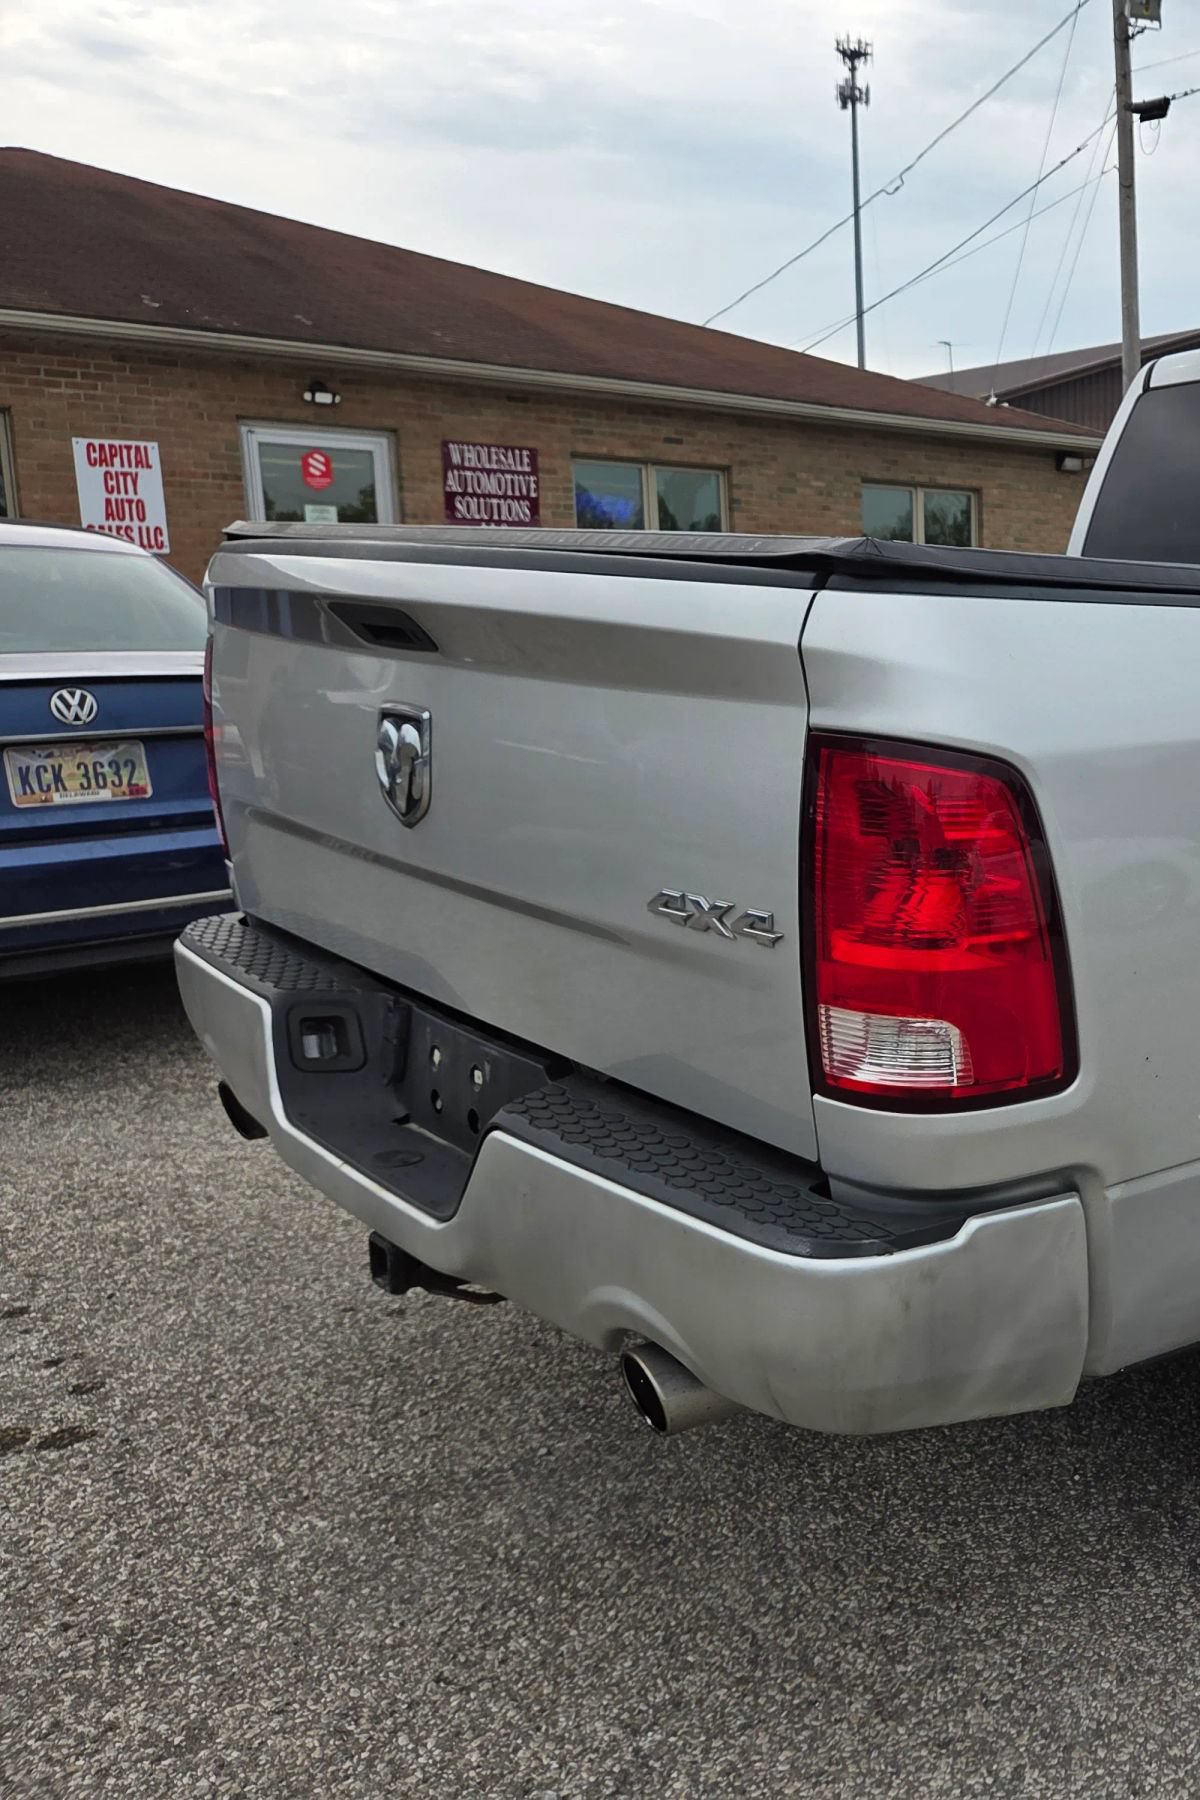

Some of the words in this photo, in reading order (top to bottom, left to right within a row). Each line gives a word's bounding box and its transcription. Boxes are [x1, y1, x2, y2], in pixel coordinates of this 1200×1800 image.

[86, 442, 152, 469] CAPITAL
[448, 443, 531, 472] WHOLESALE
[103, 470, 139, 496] CITY
[445, 468, 538, 498] AUTOMOTIVE
[104, 497, 147, 523] AUTO
[454, 495, 531, 522] SOLUTIONS
[138, 525, 165, 551] LLC
[17, 763, 69, 796] KCK
[76, 758, 140, 791] 3632
